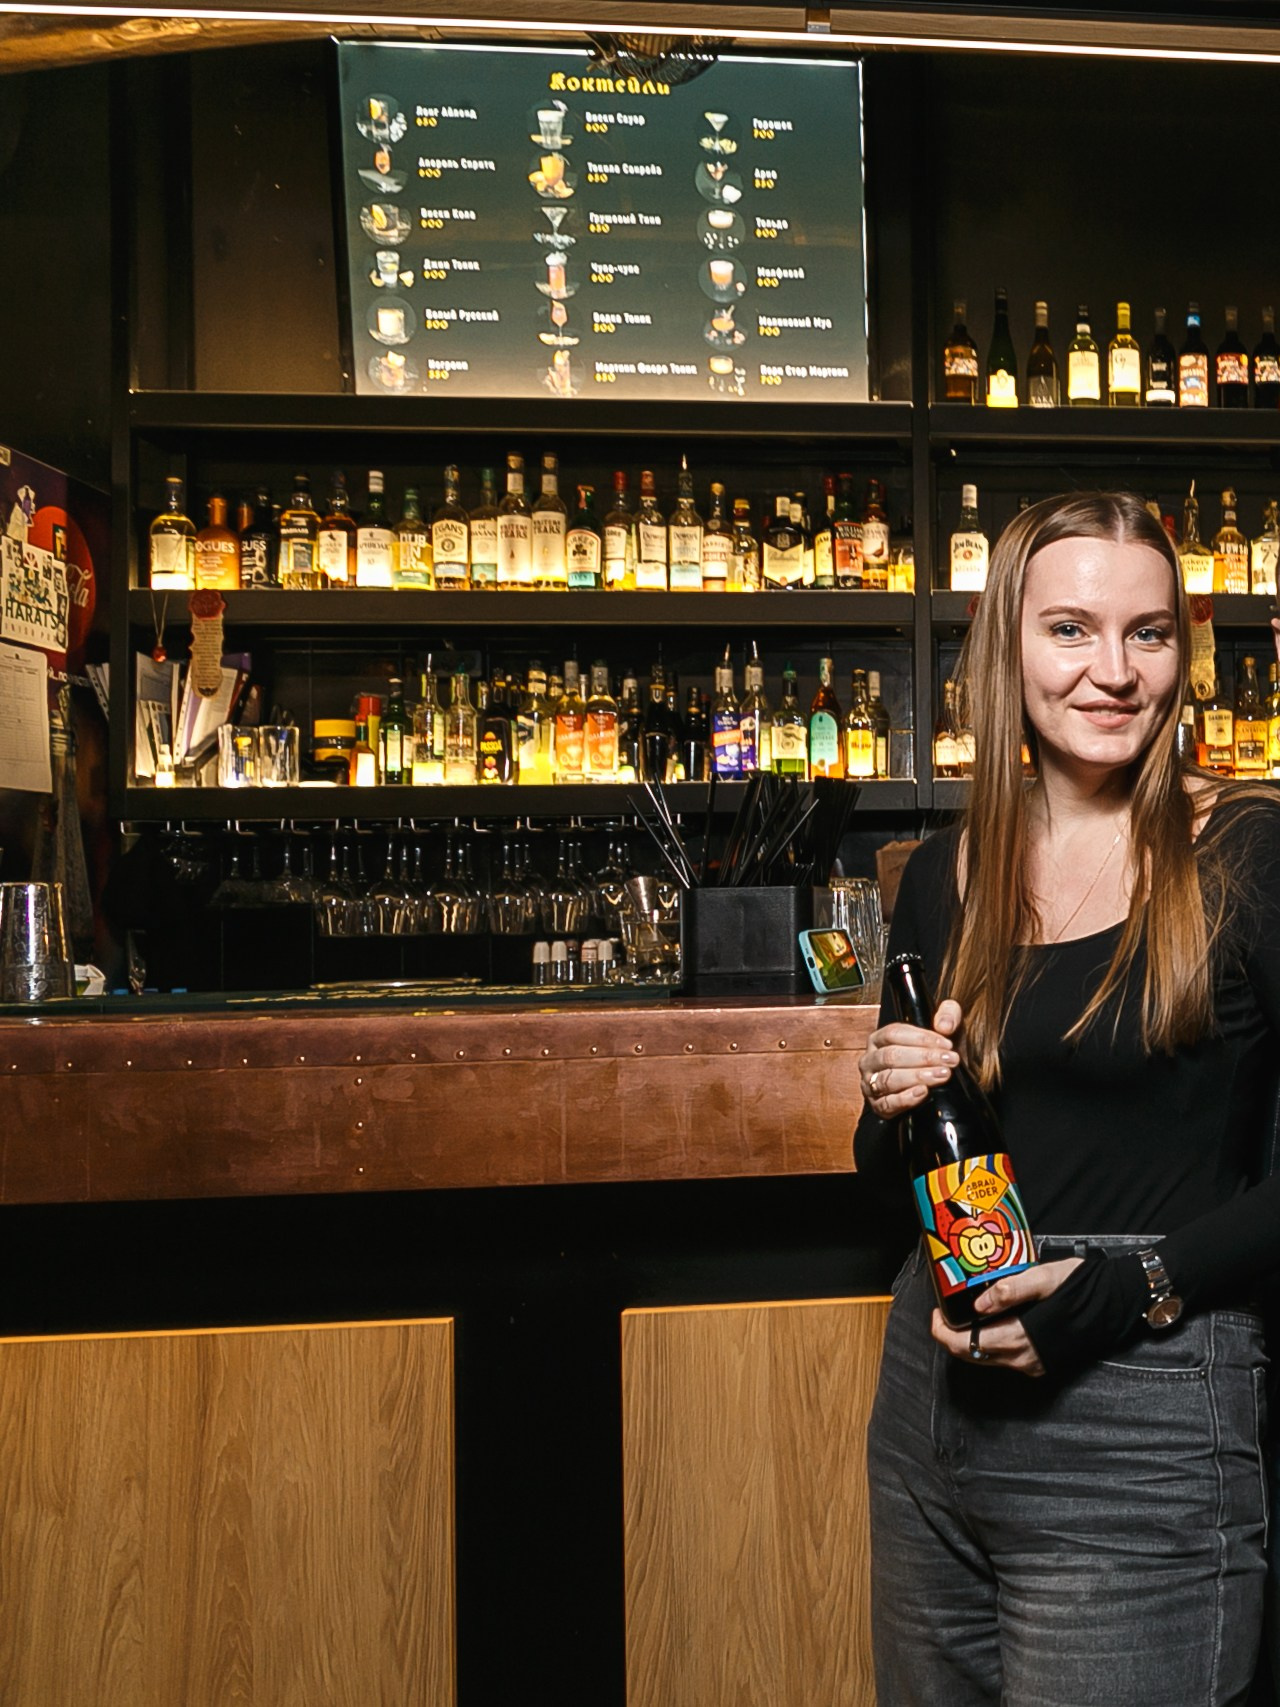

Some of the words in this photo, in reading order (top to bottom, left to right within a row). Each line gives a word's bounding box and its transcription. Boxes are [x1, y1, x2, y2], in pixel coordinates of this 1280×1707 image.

[550, 71, 671, 95] Коктейли
[966, 1178, 996, 1192] ABRAU
[967, 1186, 999, 1201] CIDER
